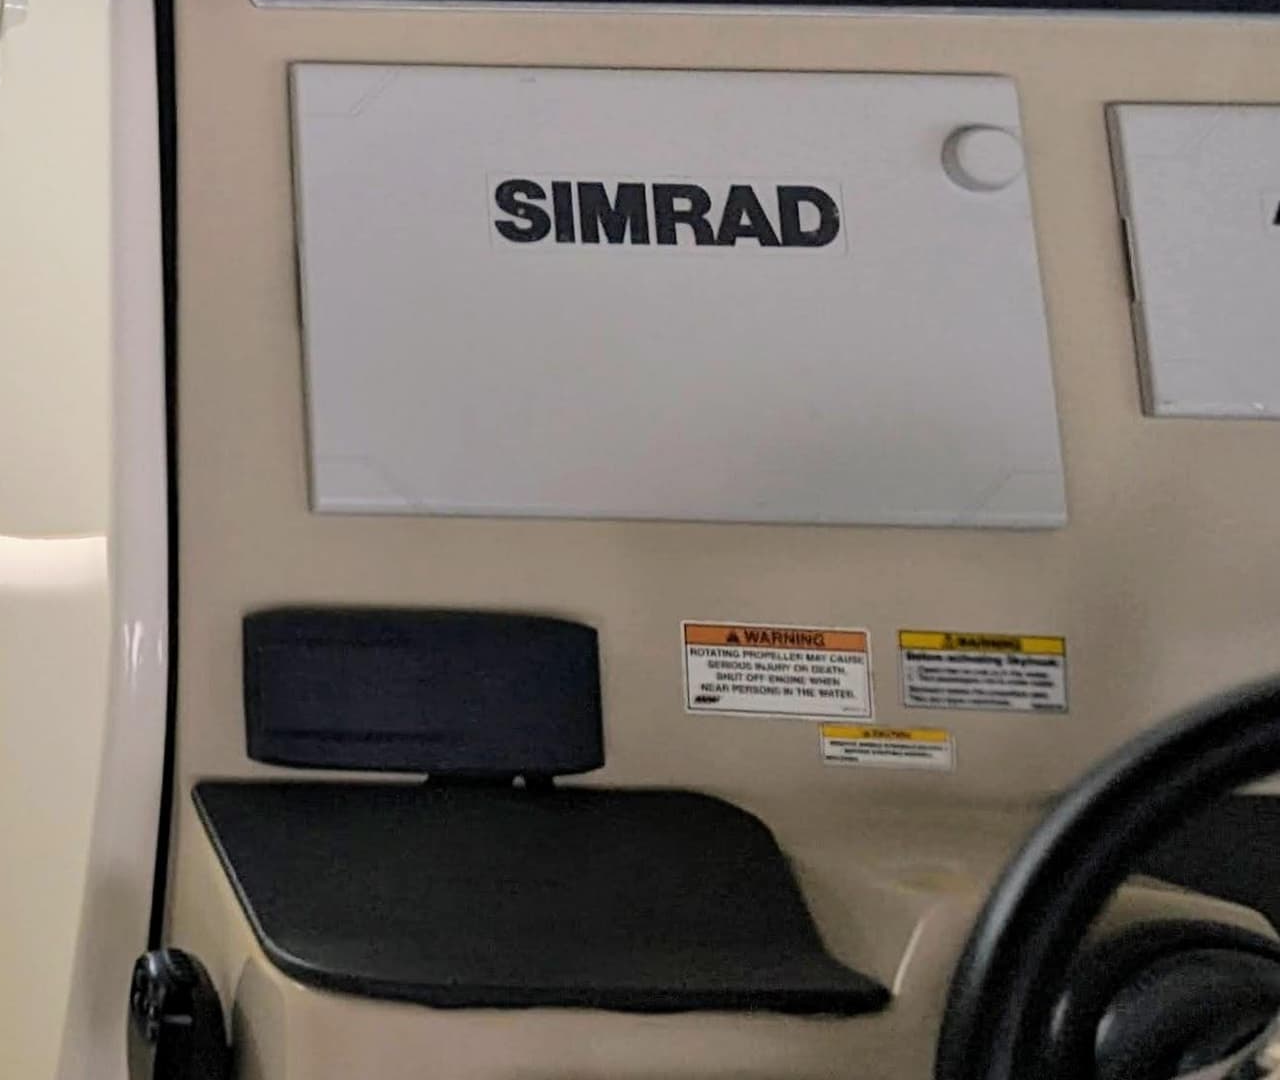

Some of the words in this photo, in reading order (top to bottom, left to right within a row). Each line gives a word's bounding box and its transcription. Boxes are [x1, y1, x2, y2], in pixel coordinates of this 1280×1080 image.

[494, 178, 839, 248] SIMRAD
[743, 629, 826, 647] WARNING
[690, 647, 740, 658] ROTATING
[743, 649, 803, 661] PROPELLER
[806, 653, 827, 663] MAY
[830, 654, 864, 665] CAUSE
[707, 660, 753, 671] SERIOUS
[755, 662, 790, 673] INJURY
[794, 663, 809, 673] OR
[716, 672, 743, 682] SHUT
[746, 673, 764, 683] OFF
[768, 674, 806, 685] ENGINE
[809, 675, 841, 686] WHEN
[701, 683, 729, 694] NEAR
[732, 685, 780, 696] PERSONS
[784, 687, 794, 696] IN
[797, 687, 815, 697] THE
